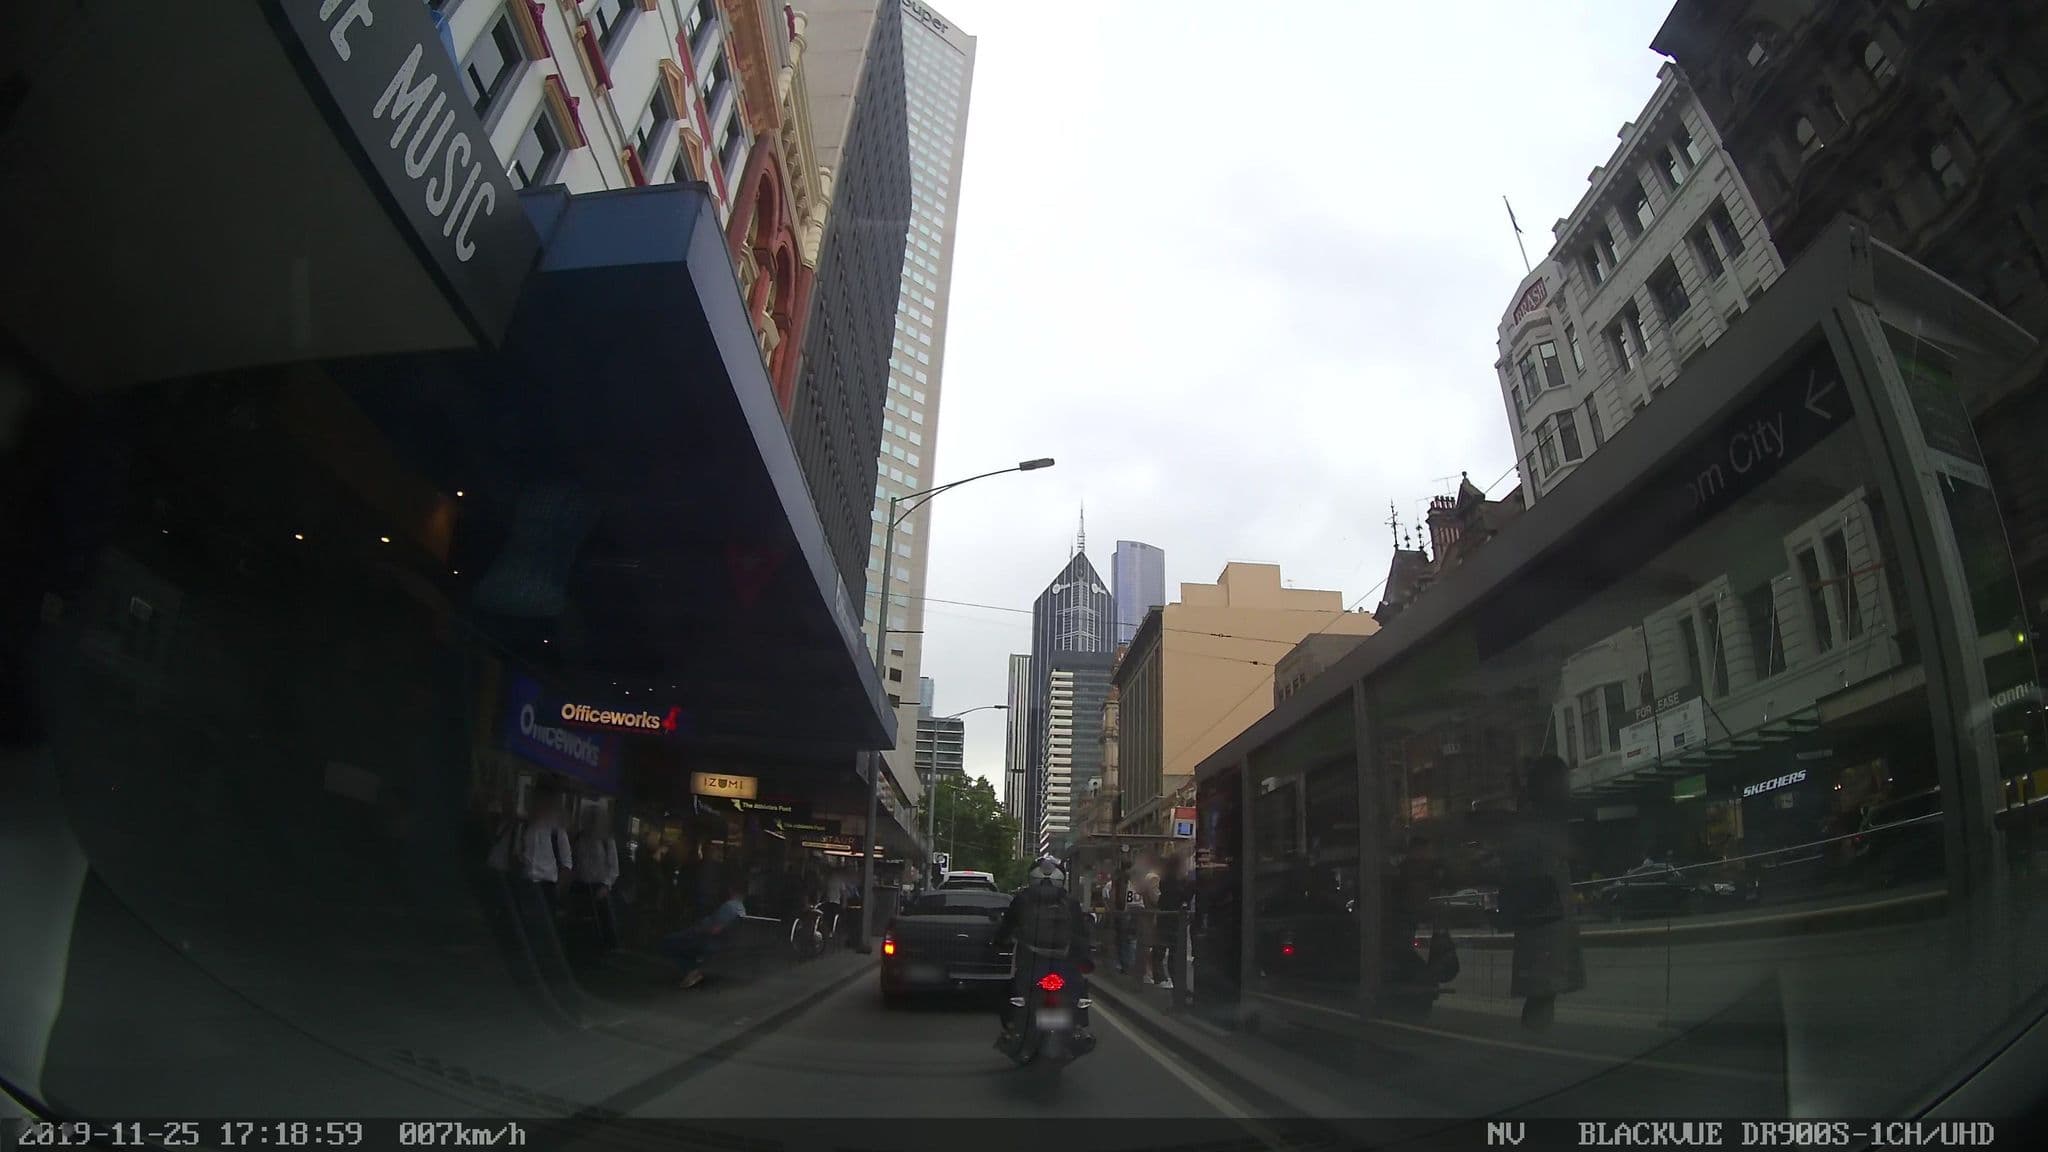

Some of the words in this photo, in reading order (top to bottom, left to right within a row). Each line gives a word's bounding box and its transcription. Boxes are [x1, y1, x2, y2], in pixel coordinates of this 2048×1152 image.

[320, 0, 374, 62] E
[373, 43, 496, 262] MUSIC
[1729, 410, 1784, 474] City
[561, 703, 661, 730] Officeworks
[1635, 705, 1653, 721] FOR
[1743, 769, 1807, 798] SKECHERS
